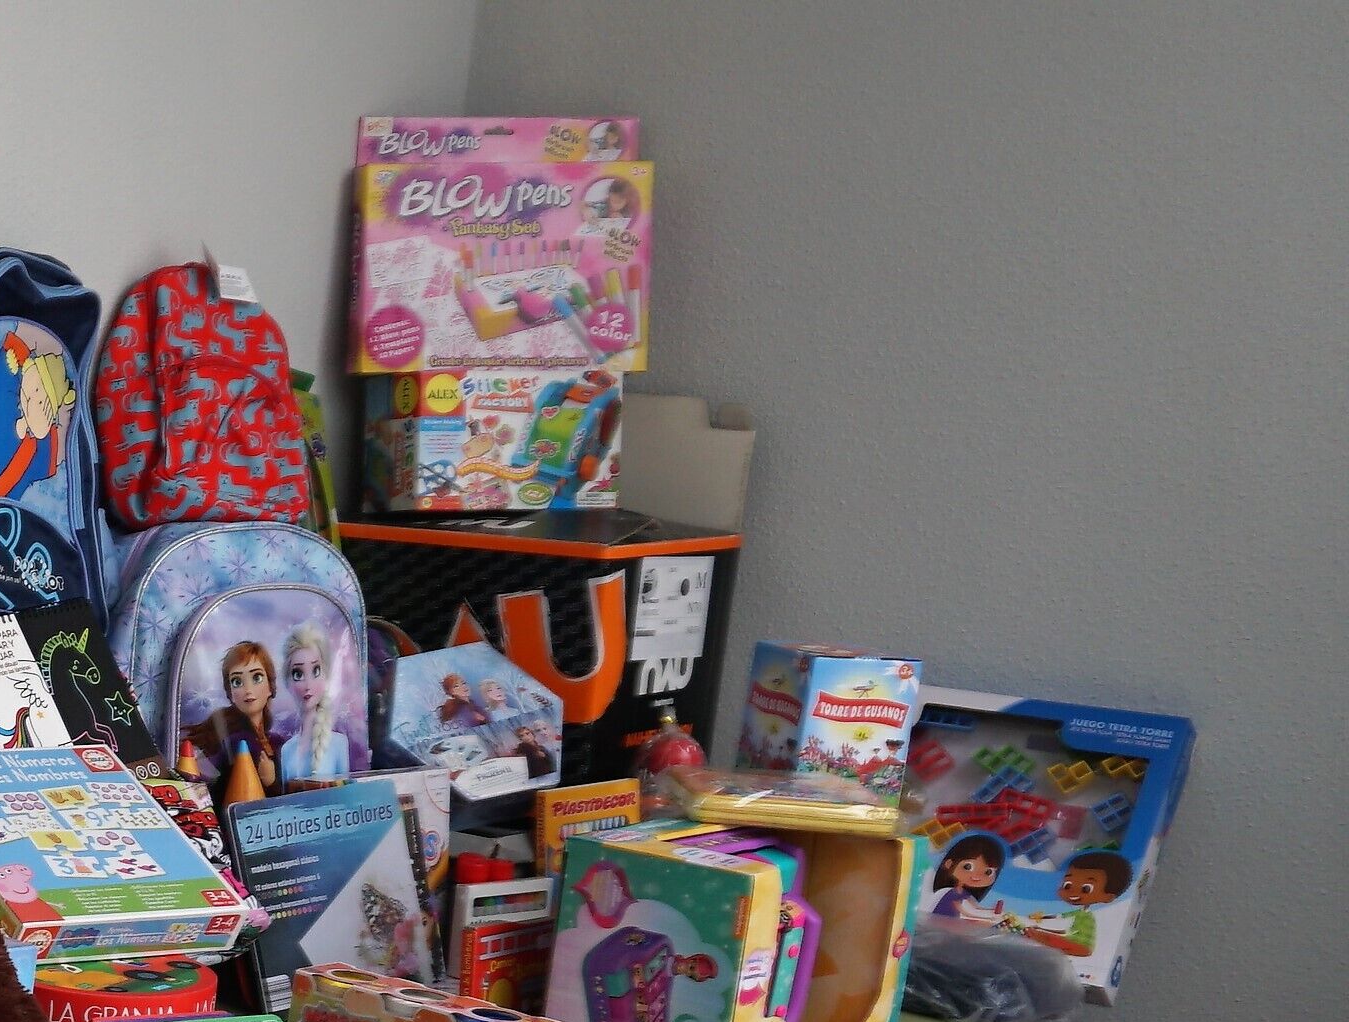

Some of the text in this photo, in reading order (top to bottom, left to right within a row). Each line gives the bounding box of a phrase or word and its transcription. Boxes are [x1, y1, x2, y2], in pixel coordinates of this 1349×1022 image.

[379, 129, 482, 156] BLOW pens
[399, 174, 576, 219] BLOW pens
[599, 310, 626, 328] 12
[589, 324, 633, 343] color
[426, 372, 543, 401] ALEX Sticker
[8, 640, 15, 648] Y
[818, 700, 849, 718] TORRE
[849, 702, 867, 718] DE
[866, 703, 906, 726] GUSANOS
[1069, 718, 1106, 729] JUEGO
[1109, 722, 1138, 734] TETRA
[1139, 727, 1176, 739] TORRE
[1, 753, 77, 770] Números
[15, 767, 89, 784] Nombres
[551, 790, 638, 817] PLASTIDECOR
[245, 803, 394, 845] 24 Lápices de colores
